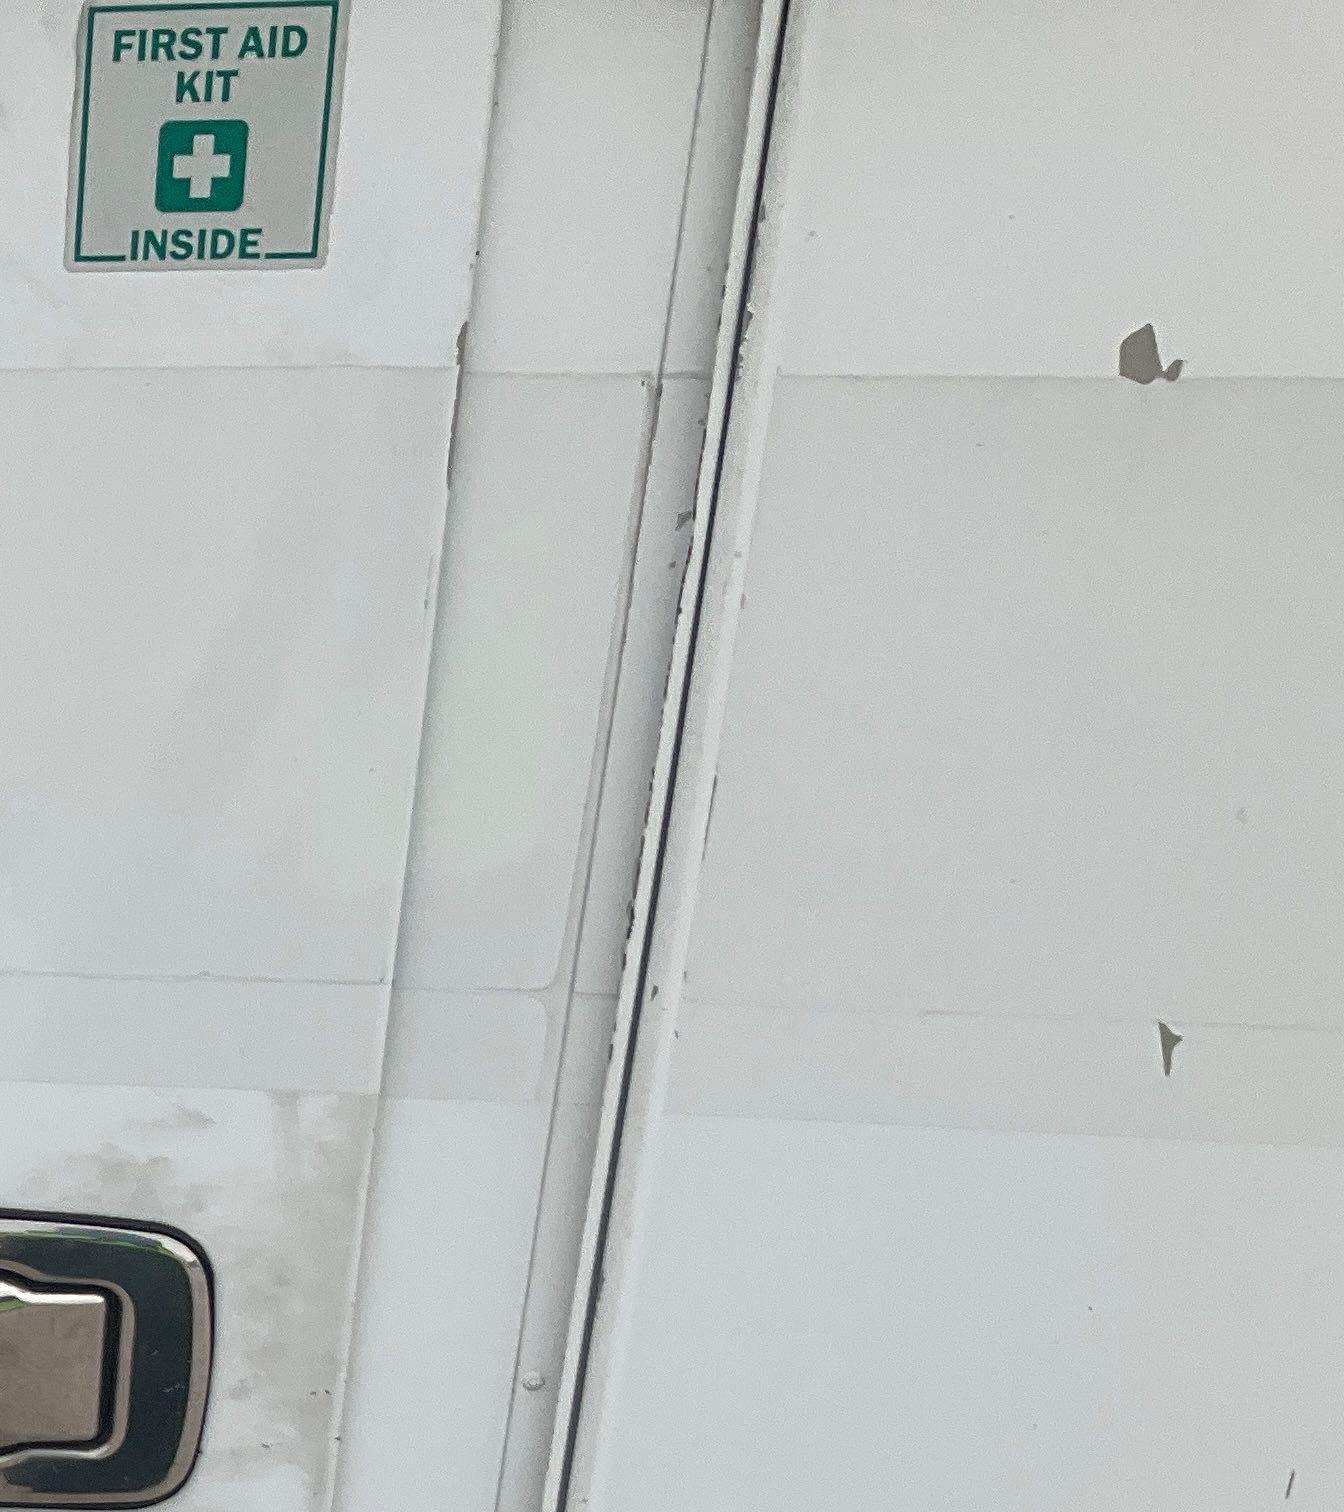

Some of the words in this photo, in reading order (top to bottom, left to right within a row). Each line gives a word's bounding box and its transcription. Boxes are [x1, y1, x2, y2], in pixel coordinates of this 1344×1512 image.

[112, 26, 228, 62] FIRST
[238, 24, 309, 60] AID
[175, 68, 239, 103] KIT
[130, 228, 263, 261] INSIDE
